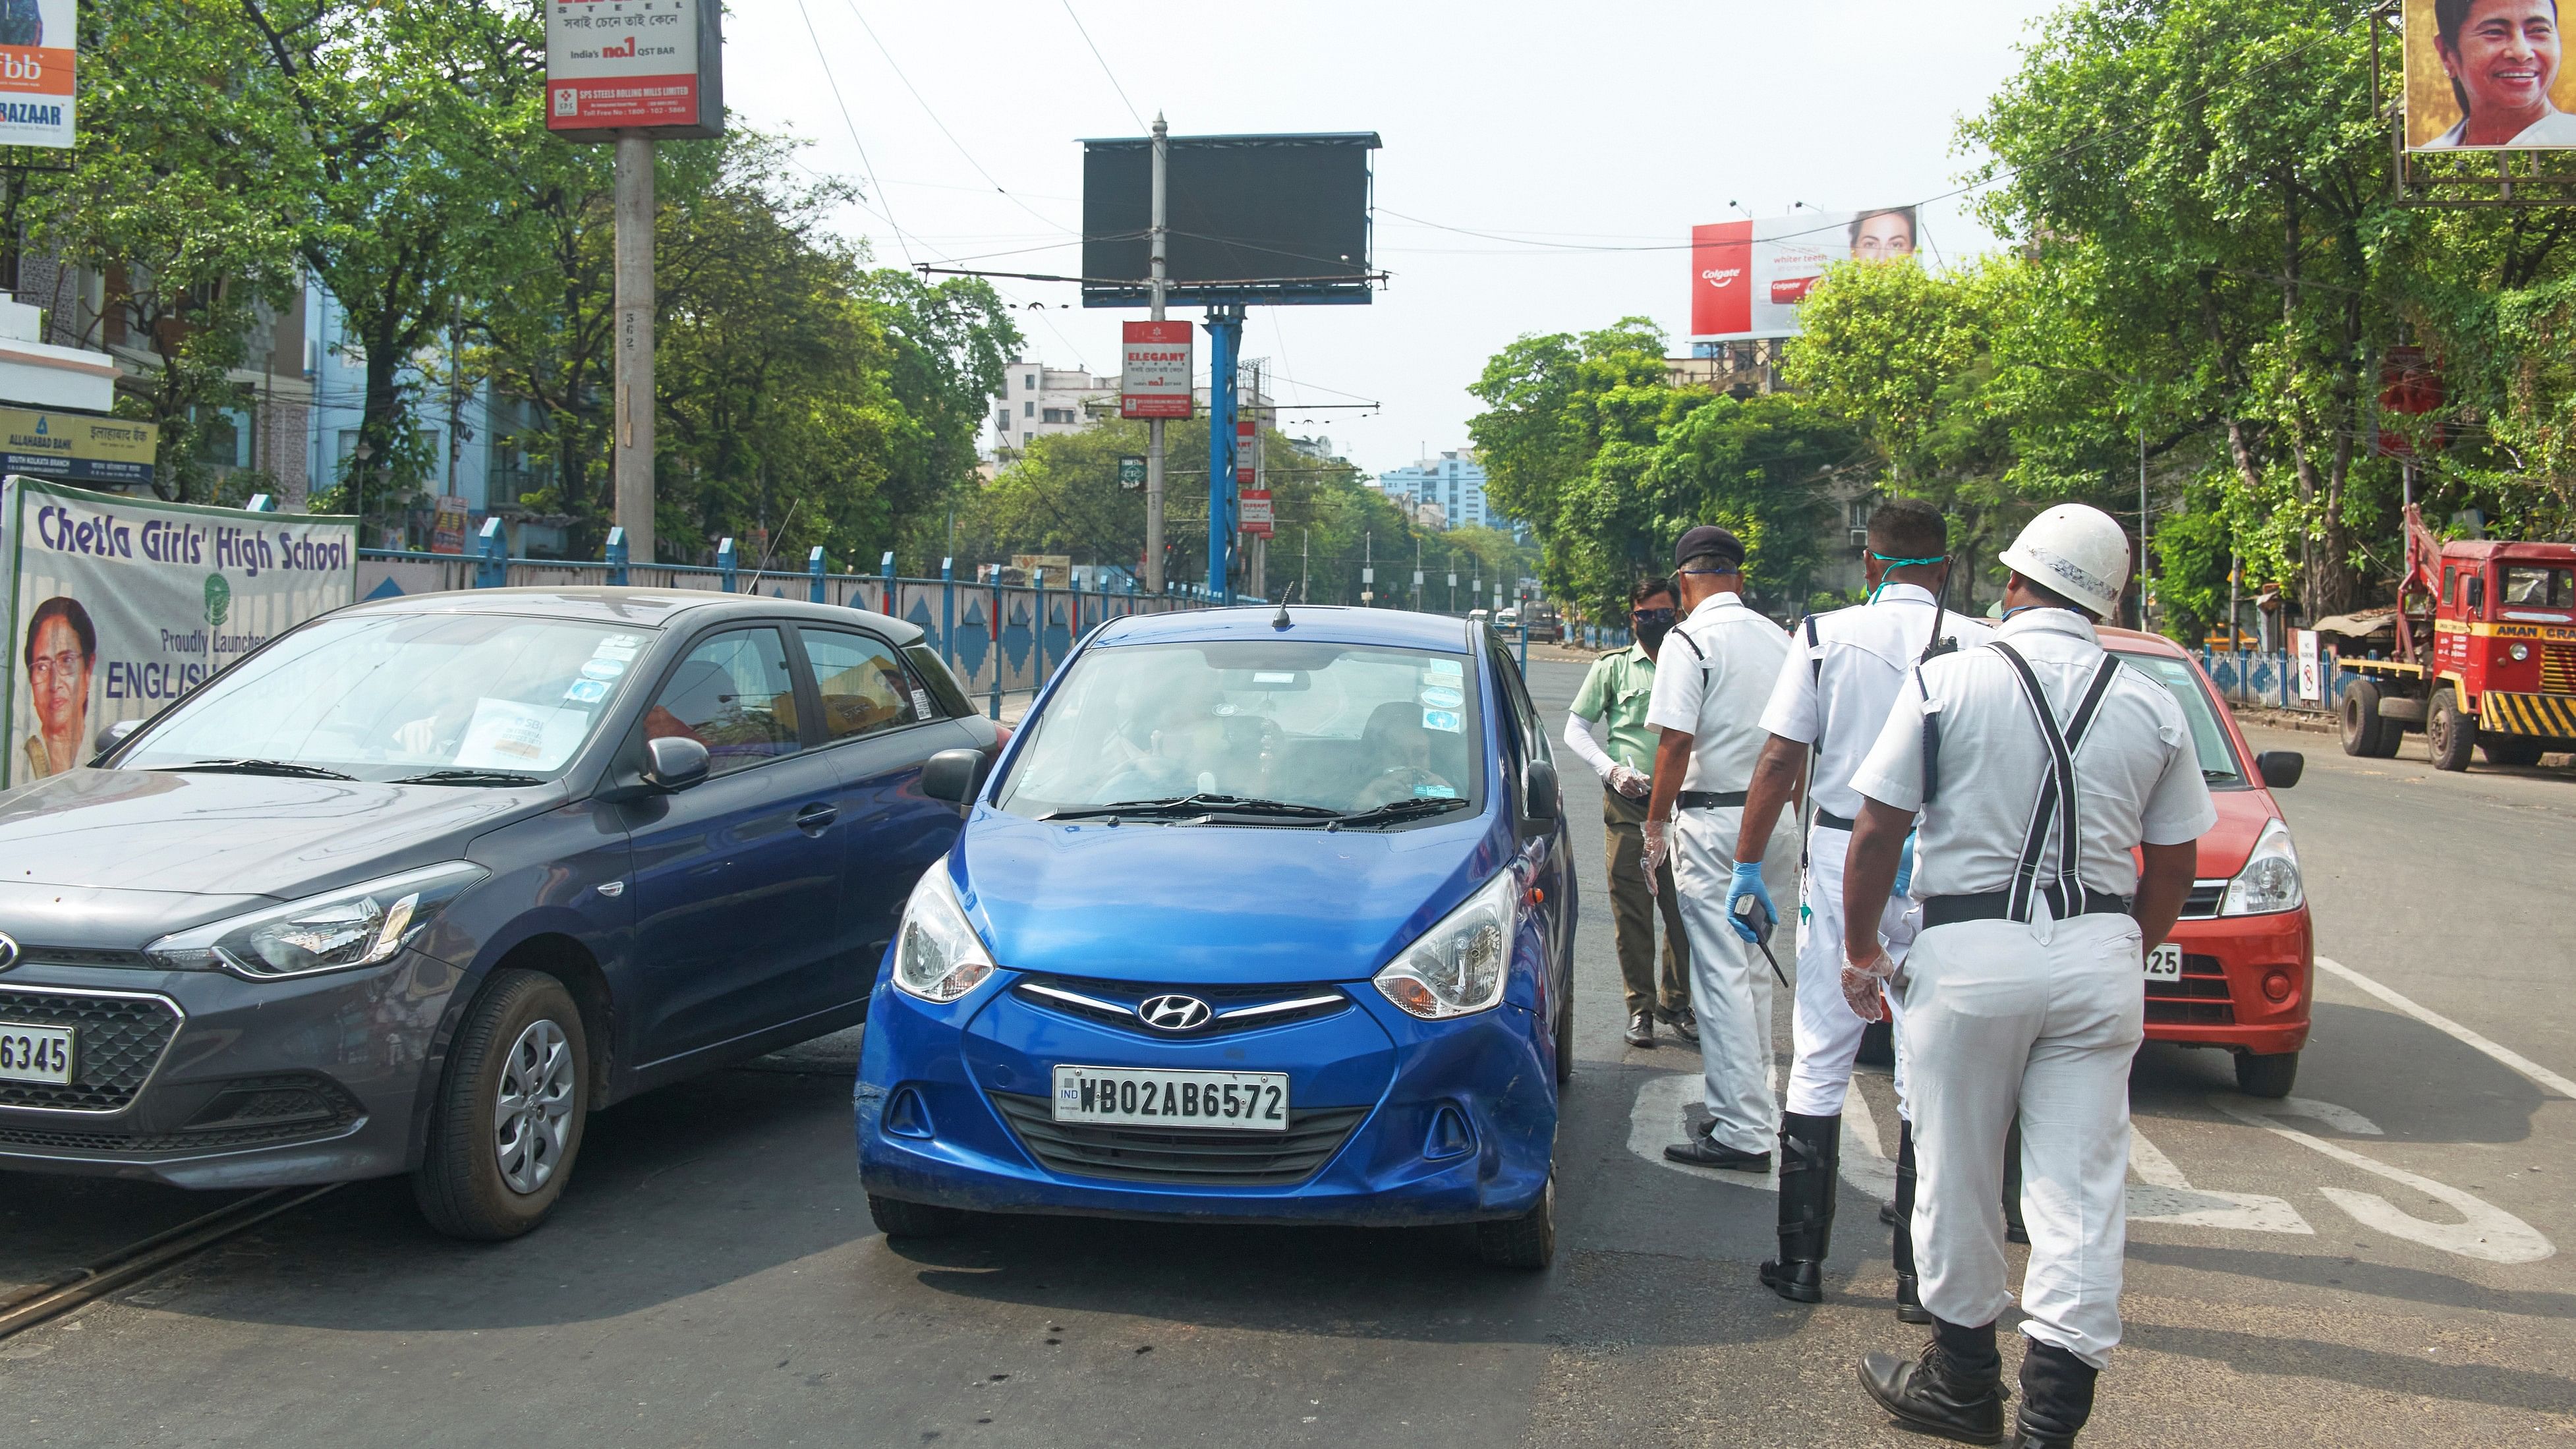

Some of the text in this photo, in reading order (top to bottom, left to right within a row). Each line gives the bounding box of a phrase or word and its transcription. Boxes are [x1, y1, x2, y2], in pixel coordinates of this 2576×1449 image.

[563, 14, 677, 29] সবাই চেনে তাই কেনে
[571, 36, 675, 59] India's no.1 QST BAR
[580, 86, 689, 99] SPS STEELS ROLLING MILLS LIMITED
[1774, 255, 1801, 264] whiter
[1702, 268, 1741, 280] Colgate
[1773, 282, 1801, 291] Colgate
[1128, 352, 1186, 362] ELEGANT
[9, 434, 72, 450] ALLAHABAD BANK
[38, 506, 347, 577] Chetla Girls' High School
[2496, 625, 2538, 637] AMAN
[160, 629, 208, 658] Proudly
[525, 718, 544, 731] SBI
[2144, 952, 2177, 975] 25
[1, 1035, 66, 1072] 6345
[1061, 1089, 1078, 1099] IND
[1080, 1078, 1282, 1120] WB02AB6572
